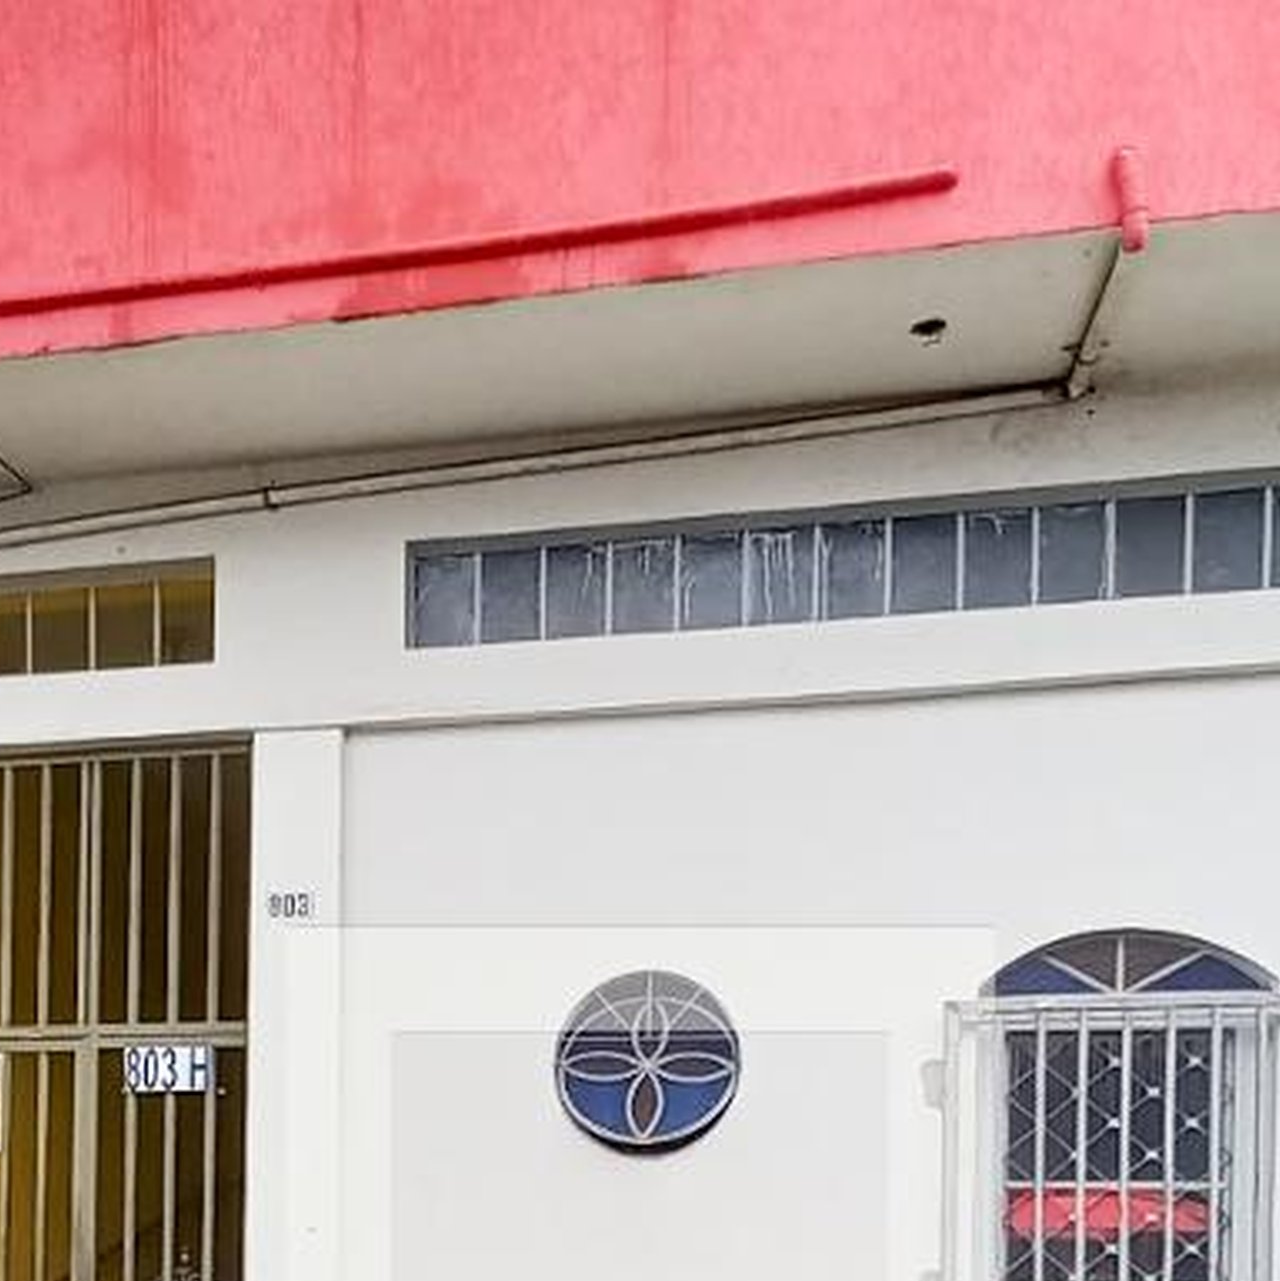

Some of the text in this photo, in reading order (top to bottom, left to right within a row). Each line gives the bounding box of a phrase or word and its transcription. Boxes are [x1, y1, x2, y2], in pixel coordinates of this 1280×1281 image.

[269, 894, 308, 918] 803
[127, 1046, 210, 1090] 803 H
